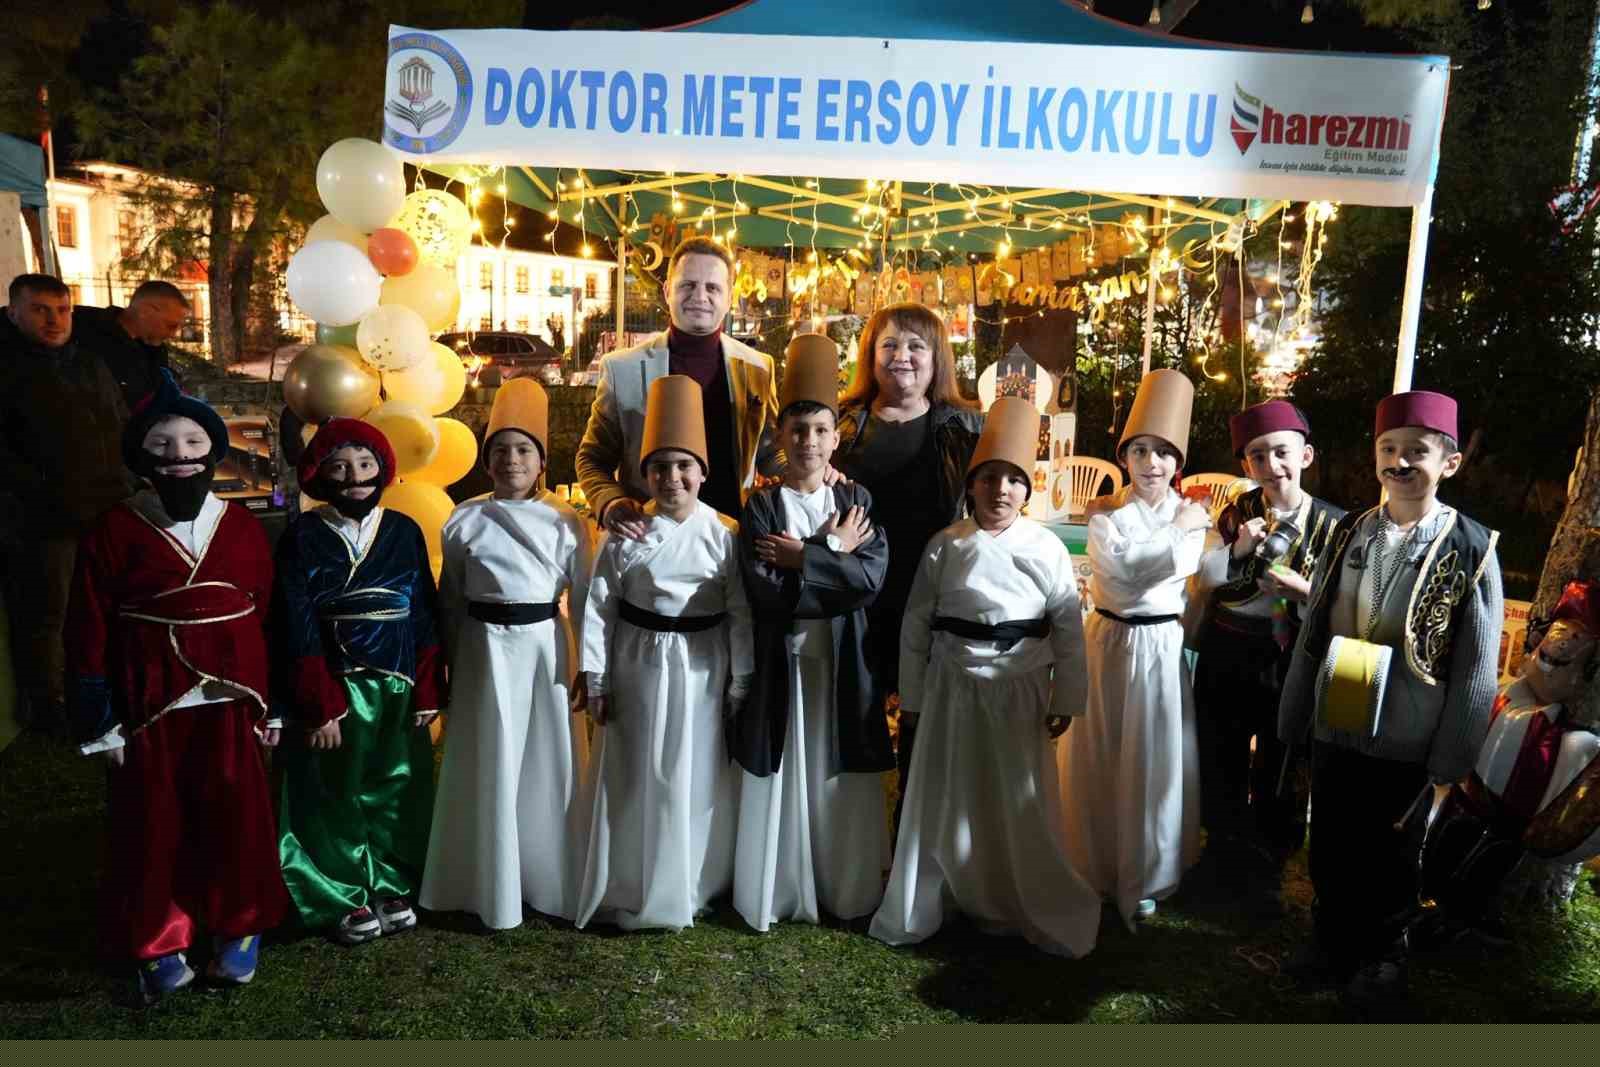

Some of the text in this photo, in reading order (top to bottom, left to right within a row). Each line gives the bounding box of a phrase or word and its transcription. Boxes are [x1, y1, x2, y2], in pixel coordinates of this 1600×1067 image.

[485, 67, 669, 134] DOKTOR
[682, 73, 802, 139] METE
[815, 78, 969, 147] ERSOY
[980, 65, 1217, 157] İLKOKULU
[1260, 104, 1412, 151] harezmi
[1324, 149, 1408, 163] Eğitim Modeli
